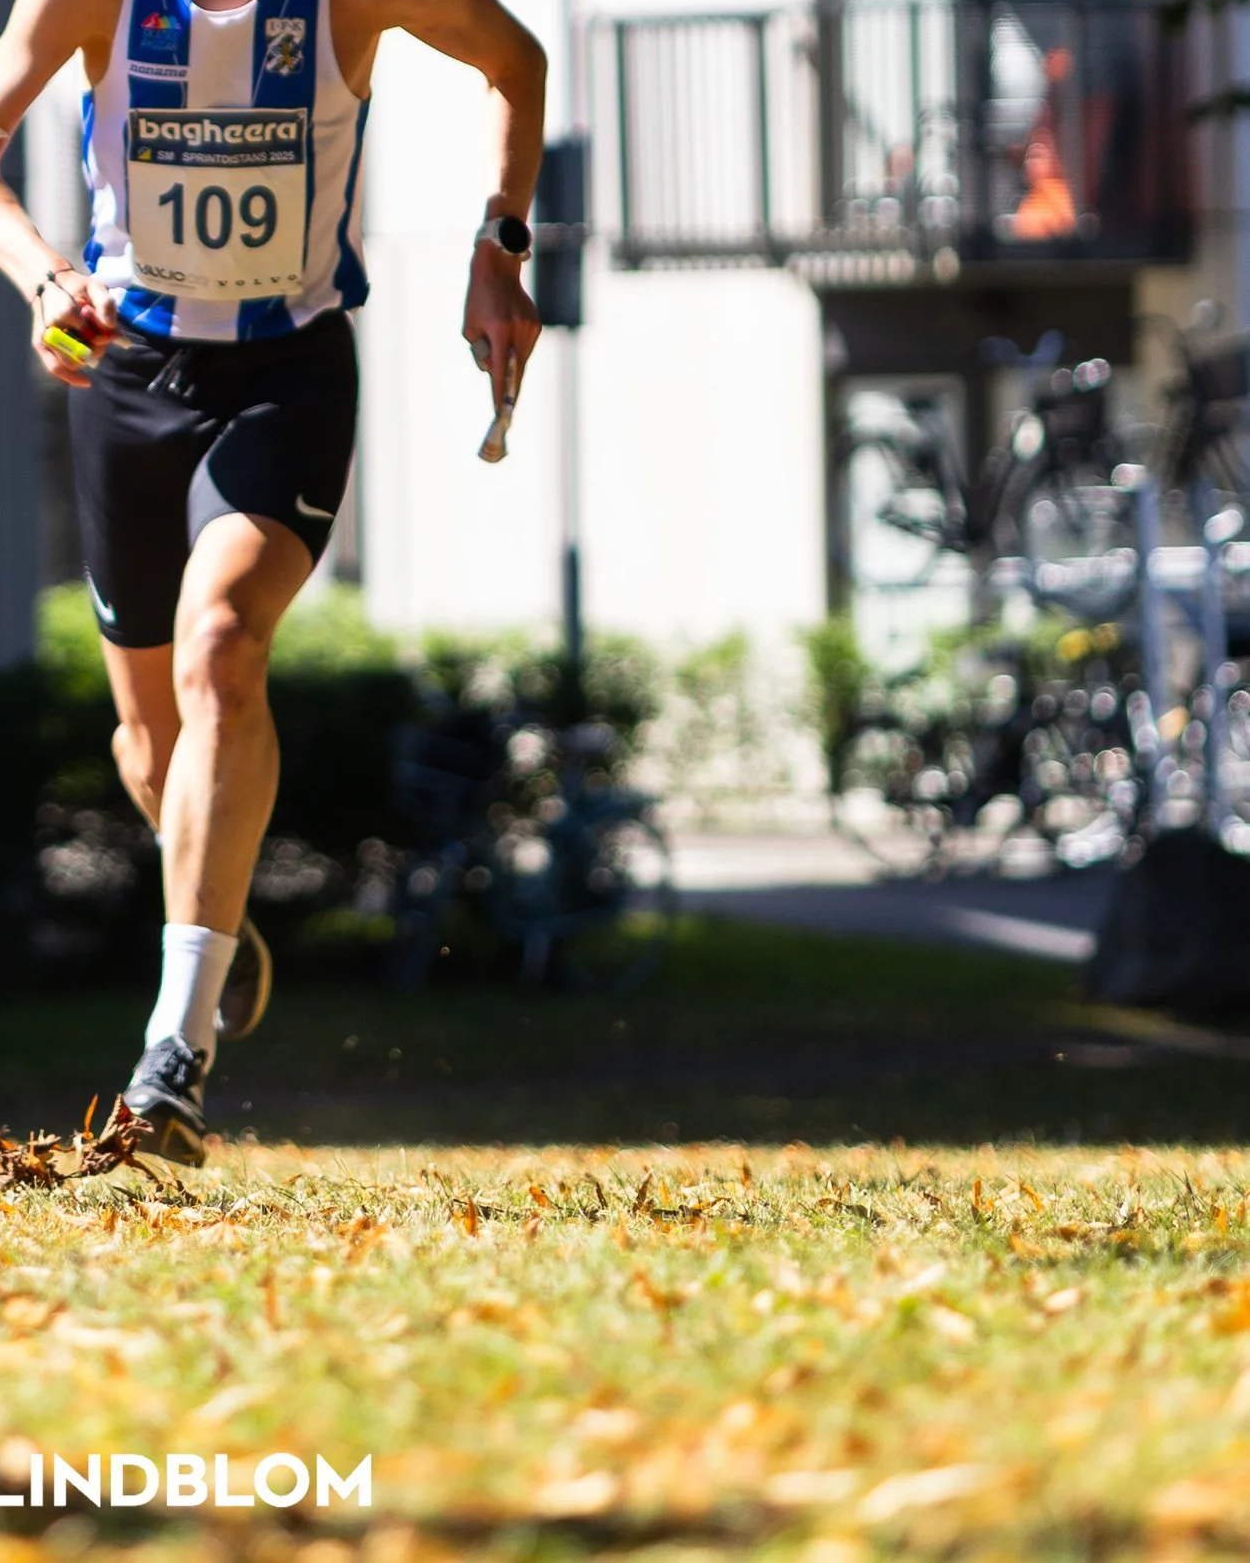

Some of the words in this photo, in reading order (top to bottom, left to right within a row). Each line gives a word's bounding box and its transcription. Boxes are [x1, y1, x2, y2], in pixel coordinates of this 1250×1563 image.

[139, 118, 297, 147] bagheera
[157, 150, 175, 161] SM
[182, 151, 267, 164] SPRINTDISTANS
[269, 150, 295, 161] 2025
[158, 182, 278, 250] 109
